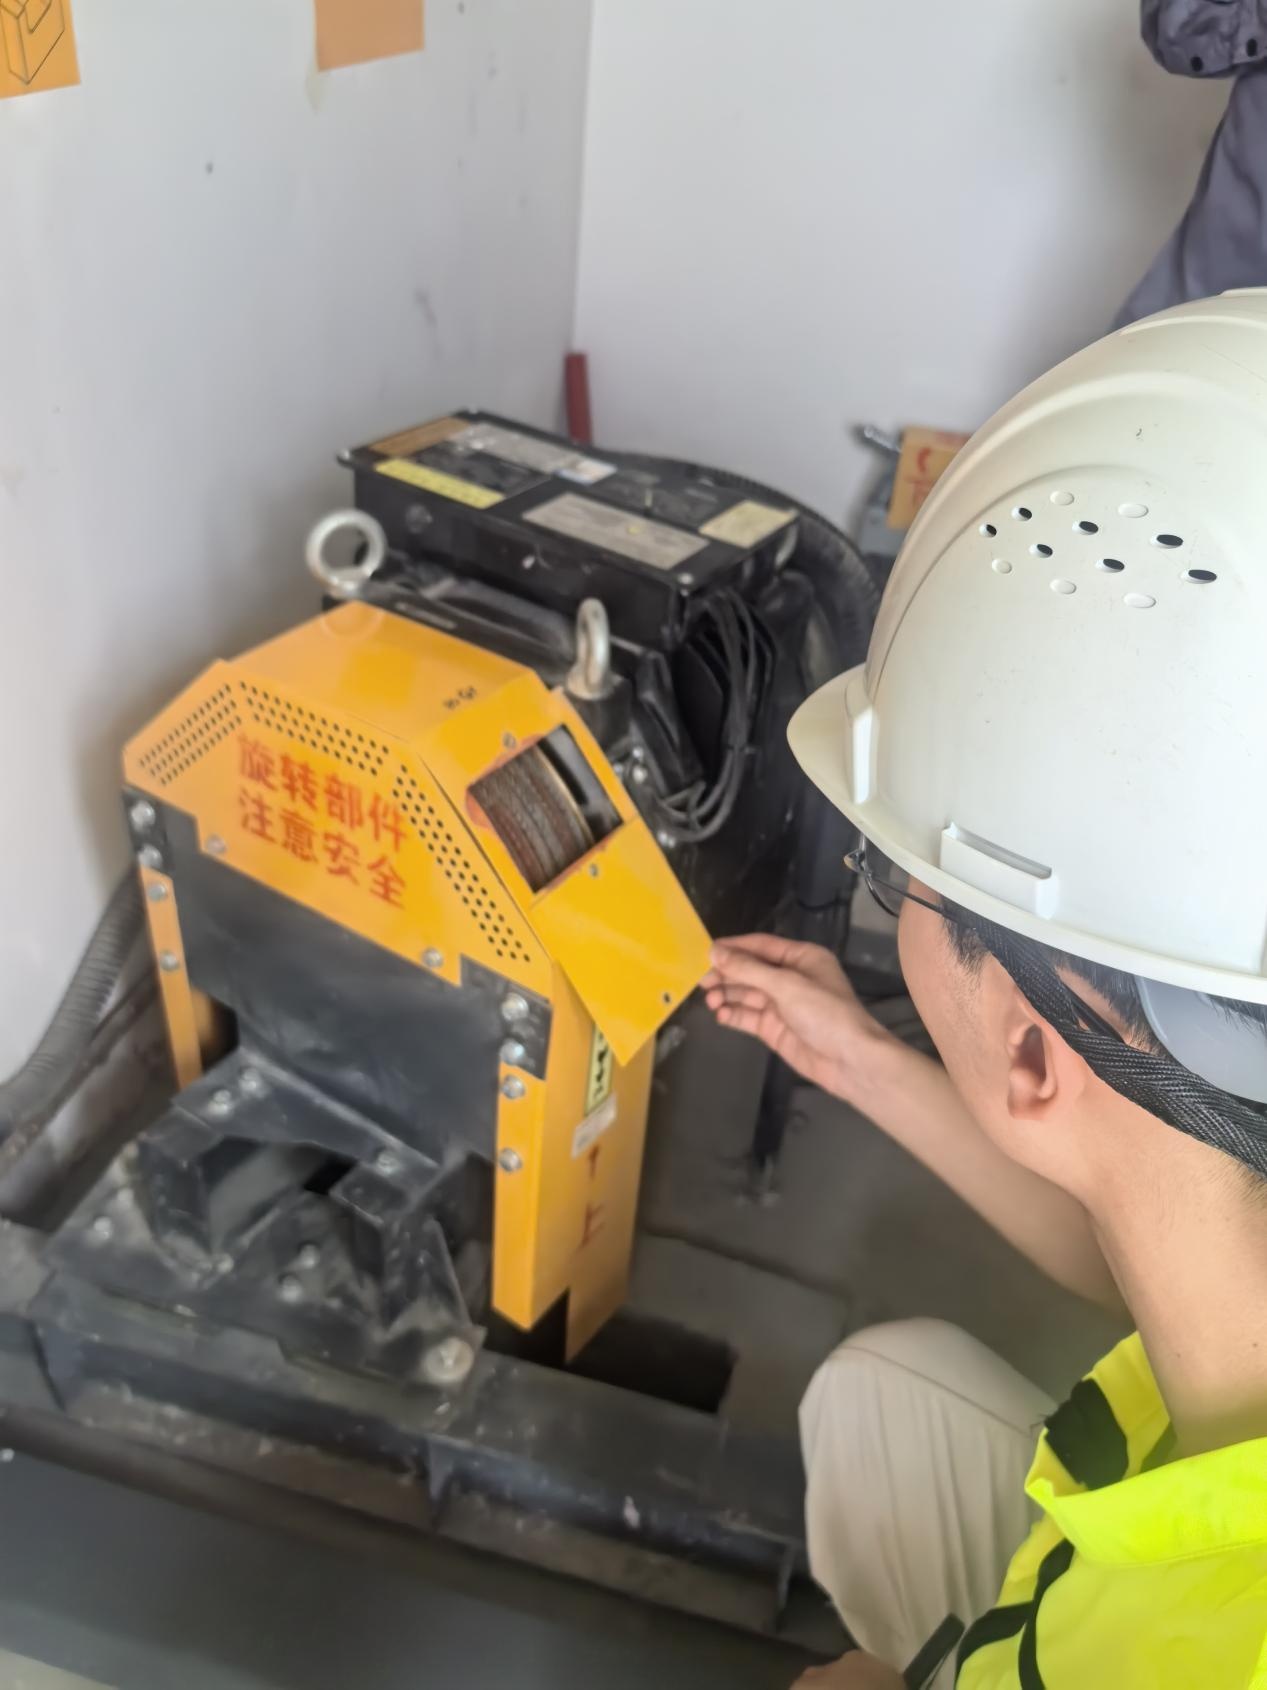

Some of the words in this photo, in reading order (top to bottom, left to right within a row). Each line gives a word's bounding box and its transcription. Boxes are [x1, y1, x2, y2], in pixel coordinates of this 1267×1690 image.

[238, 733, 407, 852] 旋转部件
[239, 787, 405, 909] 注意安全
